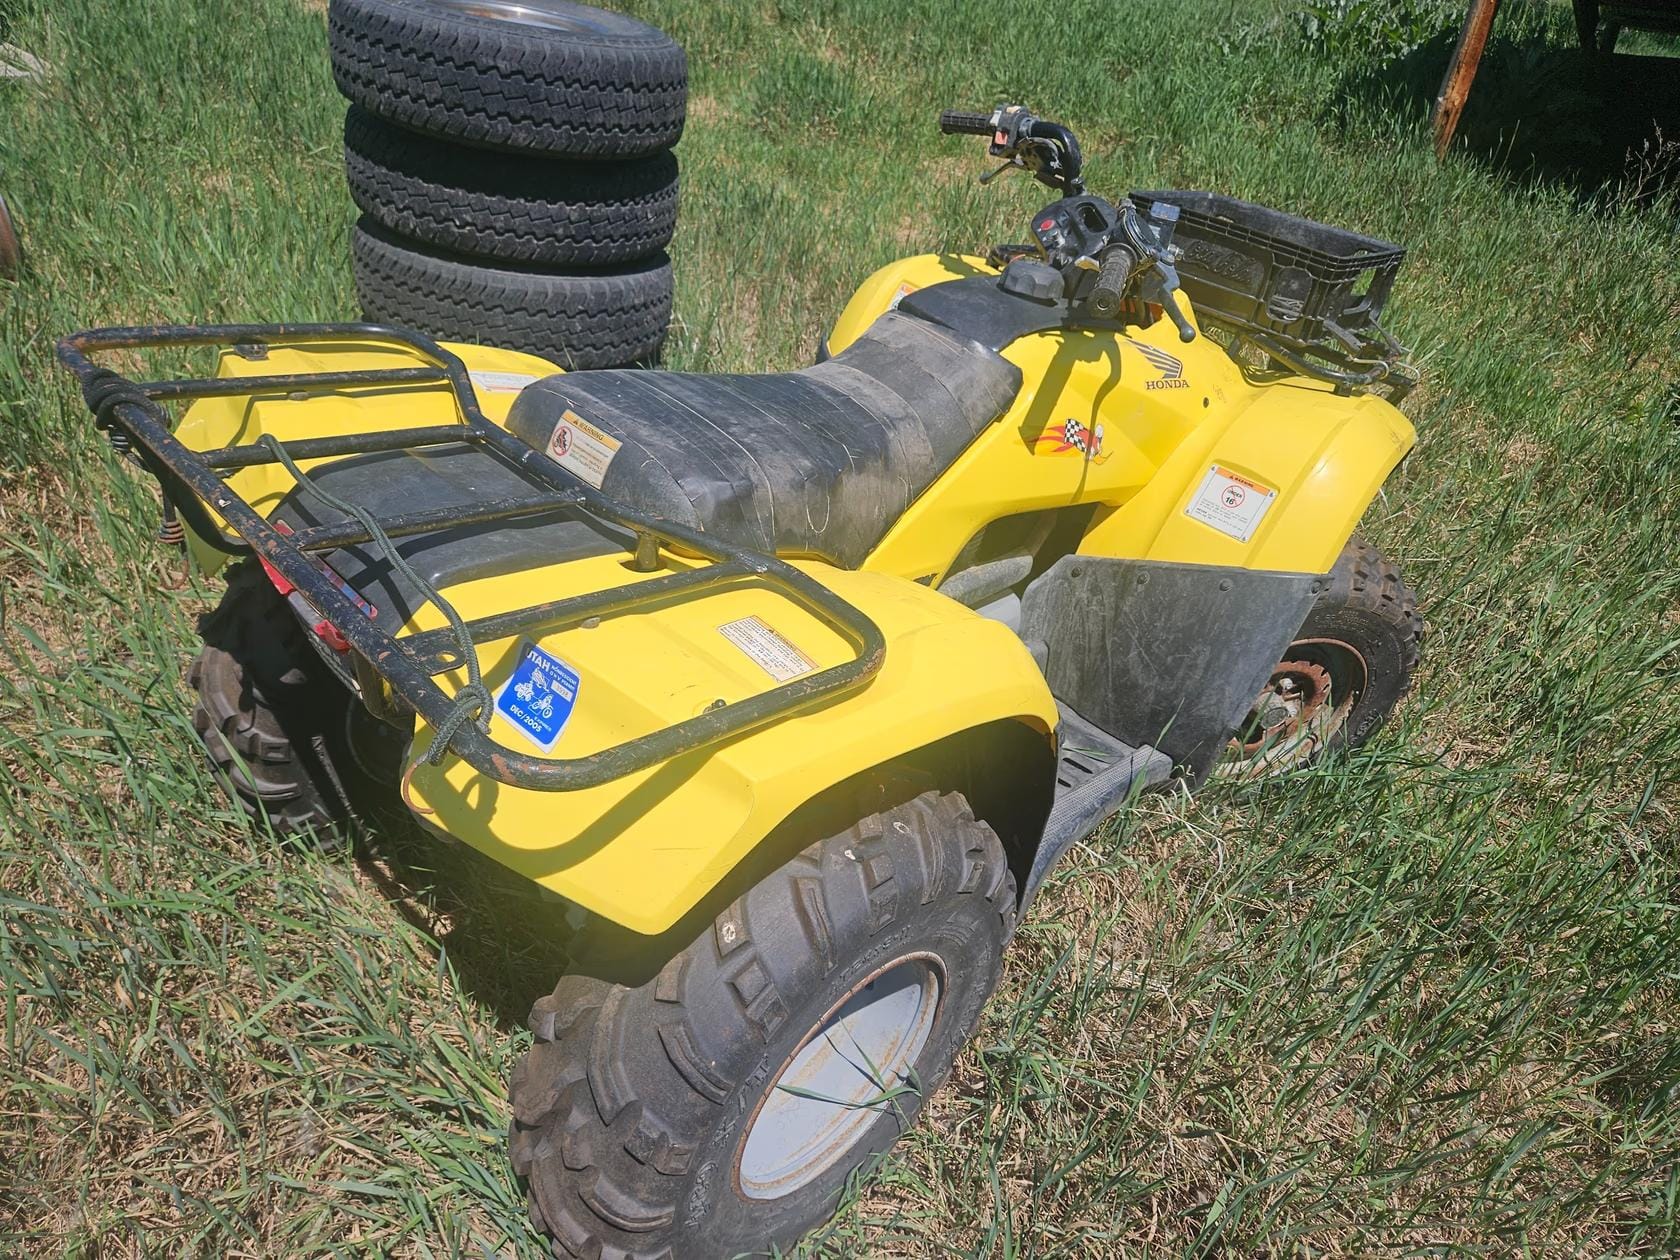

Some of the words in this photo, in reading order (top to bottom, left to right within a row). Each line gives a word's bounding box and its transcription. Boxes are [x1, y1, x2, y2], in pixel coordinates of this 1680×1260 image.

[1146, 380, 1190, 390] HONDA
[579, 421, 604, 441] WARNING
[1225, 496, 1236, 505] 16
[510, 704, 542, 732] DEC/2005
